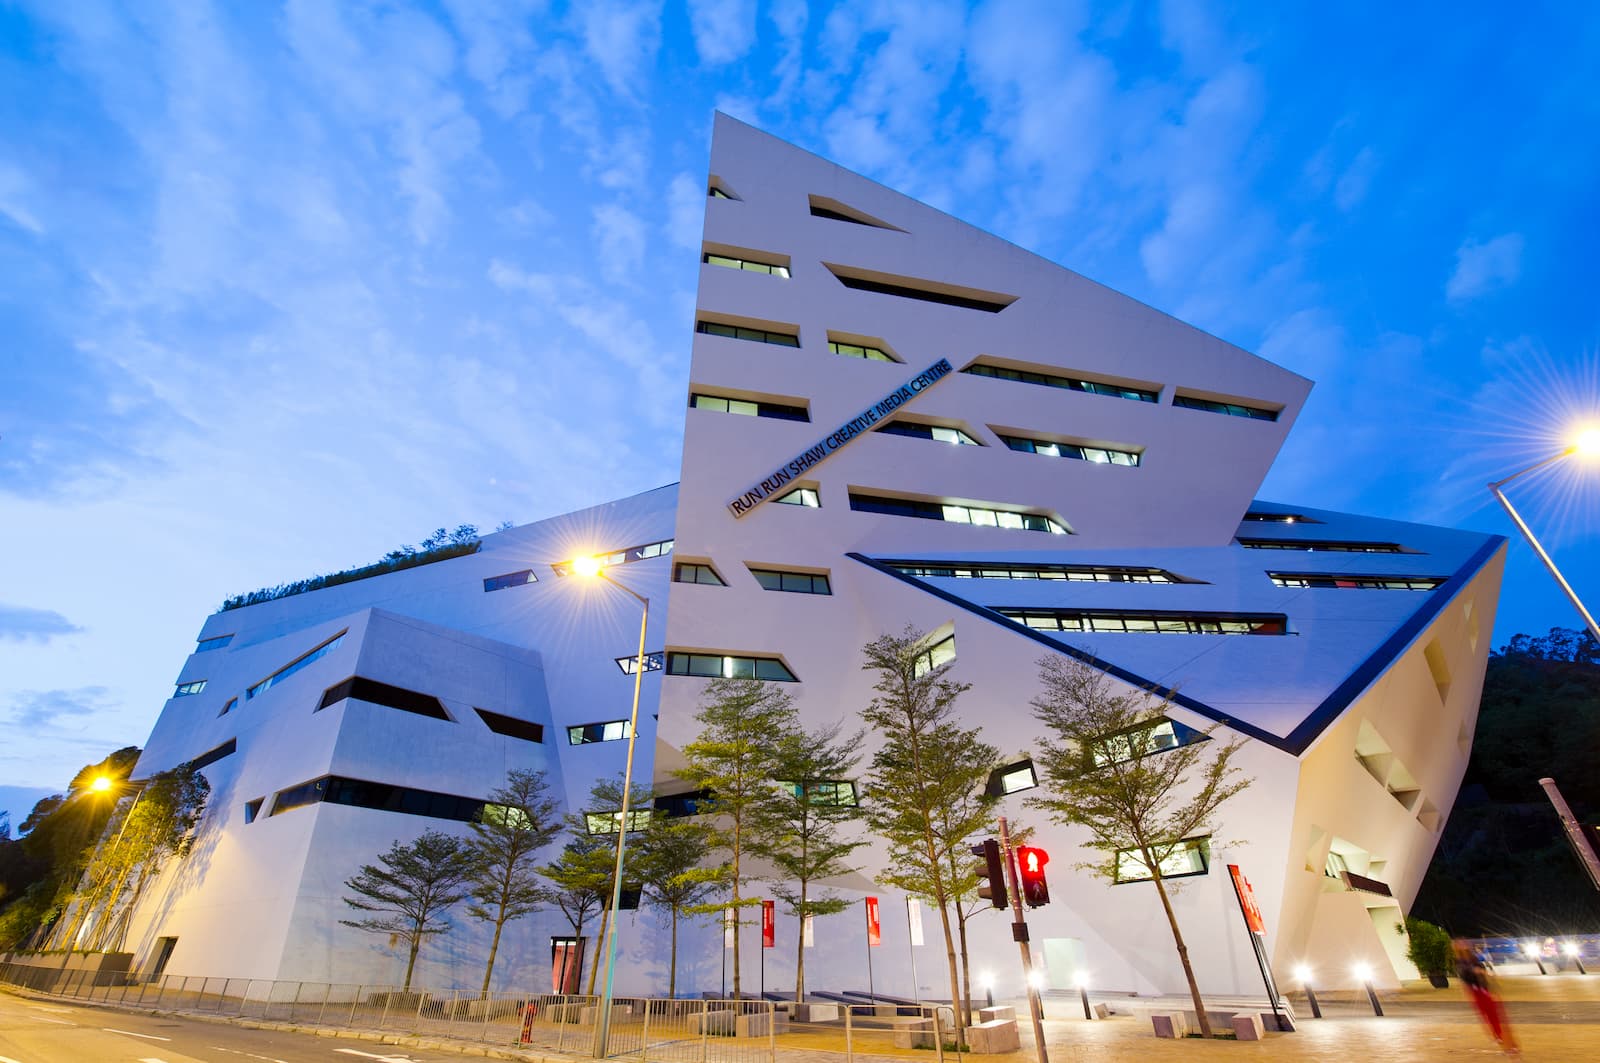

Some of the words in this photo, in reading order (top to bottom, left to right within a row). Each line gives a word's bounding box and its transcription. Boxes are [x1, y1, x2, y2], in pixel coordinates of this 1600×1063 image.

[732, 487, 763, 514] RUN
[760, 468, 791, 495] RUN
[789, 444, 826, 475] SHAW
[826, 409, 878, 449] CREATIVE
[875, 387, 913, 416] MEDIA
[910, 360, 950, 392] CENTRE
